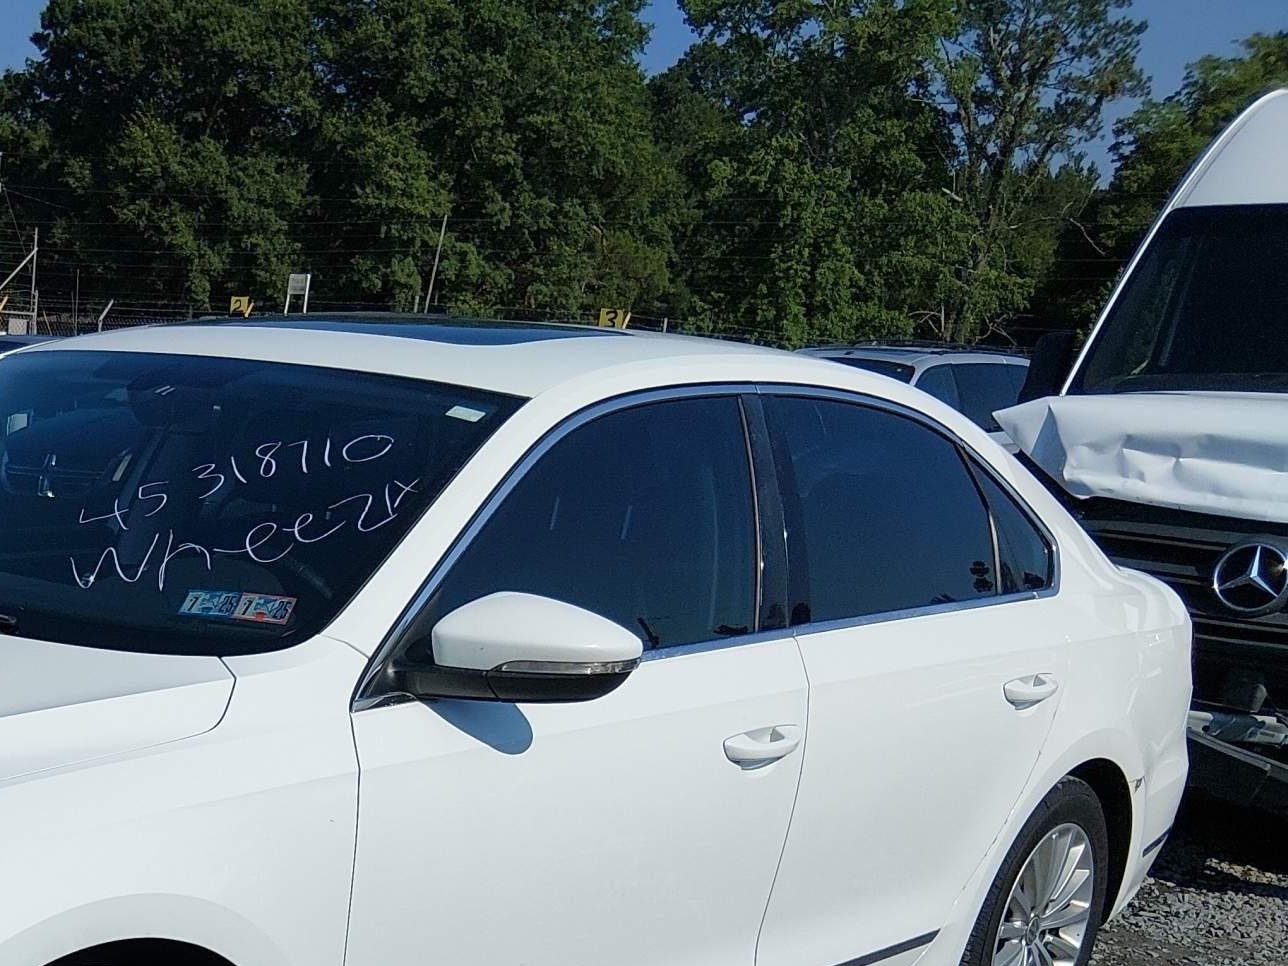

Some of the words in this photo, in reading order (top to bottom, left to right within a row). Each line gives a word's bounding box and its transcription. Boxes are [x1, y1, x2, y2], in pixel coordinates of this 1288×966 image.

[605, 310, 618, 328] 3
[241, 599, 253, 616] 7
[272, 600, 292, 619] 25
